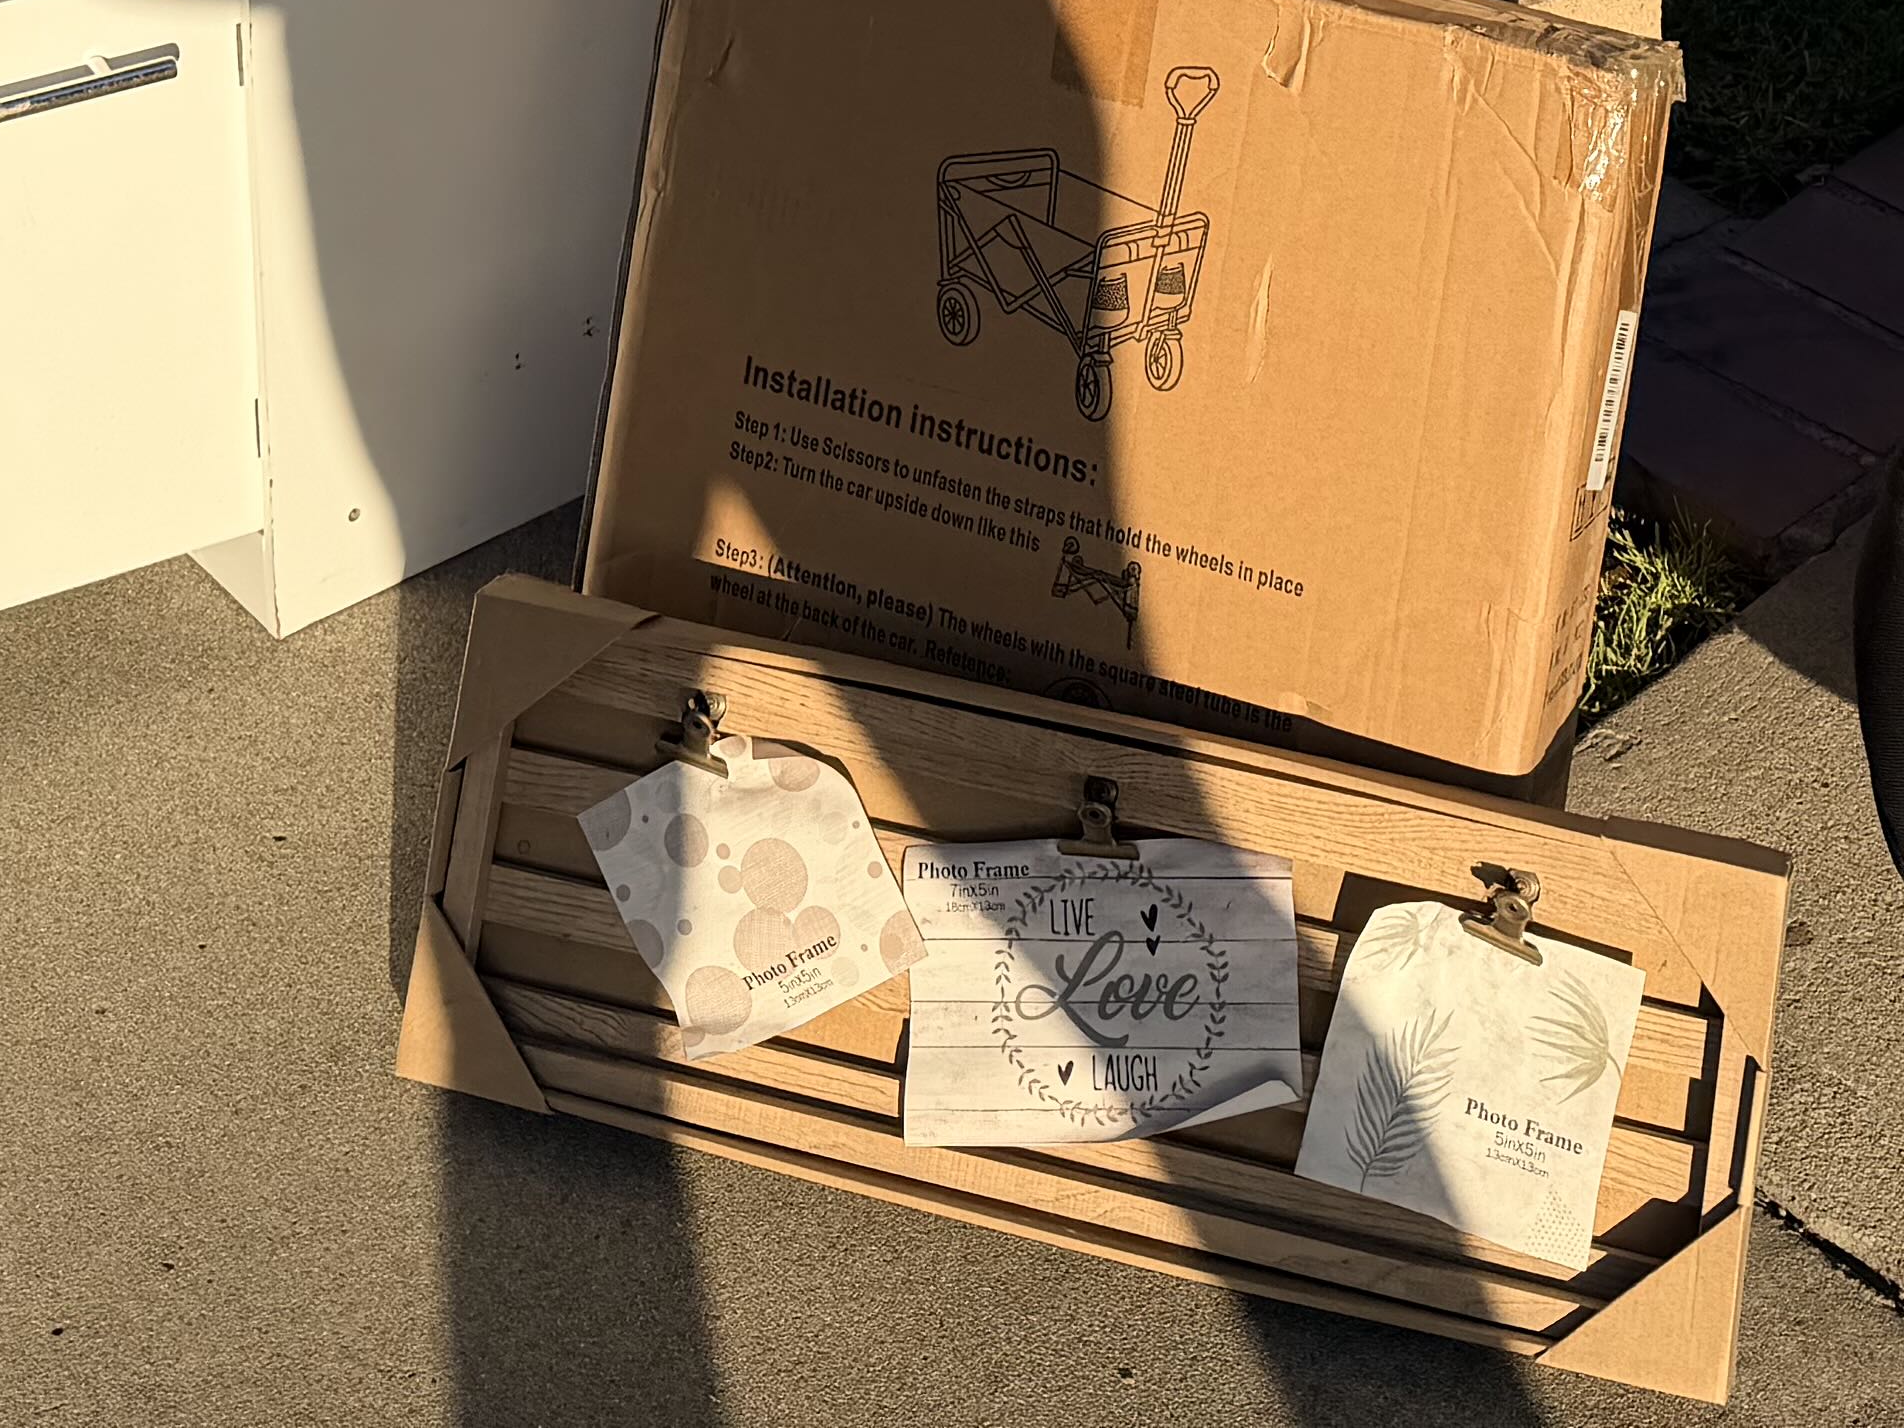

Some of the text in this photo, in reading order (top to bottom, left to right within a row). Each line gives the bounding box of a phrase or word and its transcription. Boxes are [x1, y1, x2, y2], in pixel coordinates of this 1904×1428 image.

[744, 355, 1097, 486] Installation instructions:
[730, 442, 1041, 553] Step2: Turn the car upside down like this
[735, 411, 1304, 597] Step 1: Use Scissors to unfasten the straps that hold the wheels in place
[710, 574, 754, 601] wheel
[757, 587, 771, 608] at
[774, 591, 799, 616] the
[802, 601, 838, 630] back
[842, 614, 859, 634] of
[861, 619, 885, 644] the
[716, 538, 764, 570] Step3:
[767, 553, 862, 605] (Attention,
[866, 587, 934, 628] please)
[938, 607, 967, 634] The
[970, 621, 1027, 652] wheels
[1030, 639, 1064, 665] with
[1069, 650, 1094, 674] the
[1098, 661, 1157, 691] square
[918, 861, 1030, 879] Photo Frame
[1050, 898, 1096, 936] LIVE
[741, 935, 837, 991] Photo Frame
[1015, 930, 1200, 1048] Love
[1092, 1053, 1159, 1092] LAUGH
[1464, 1097, 1584, 1155] Photo Frame
